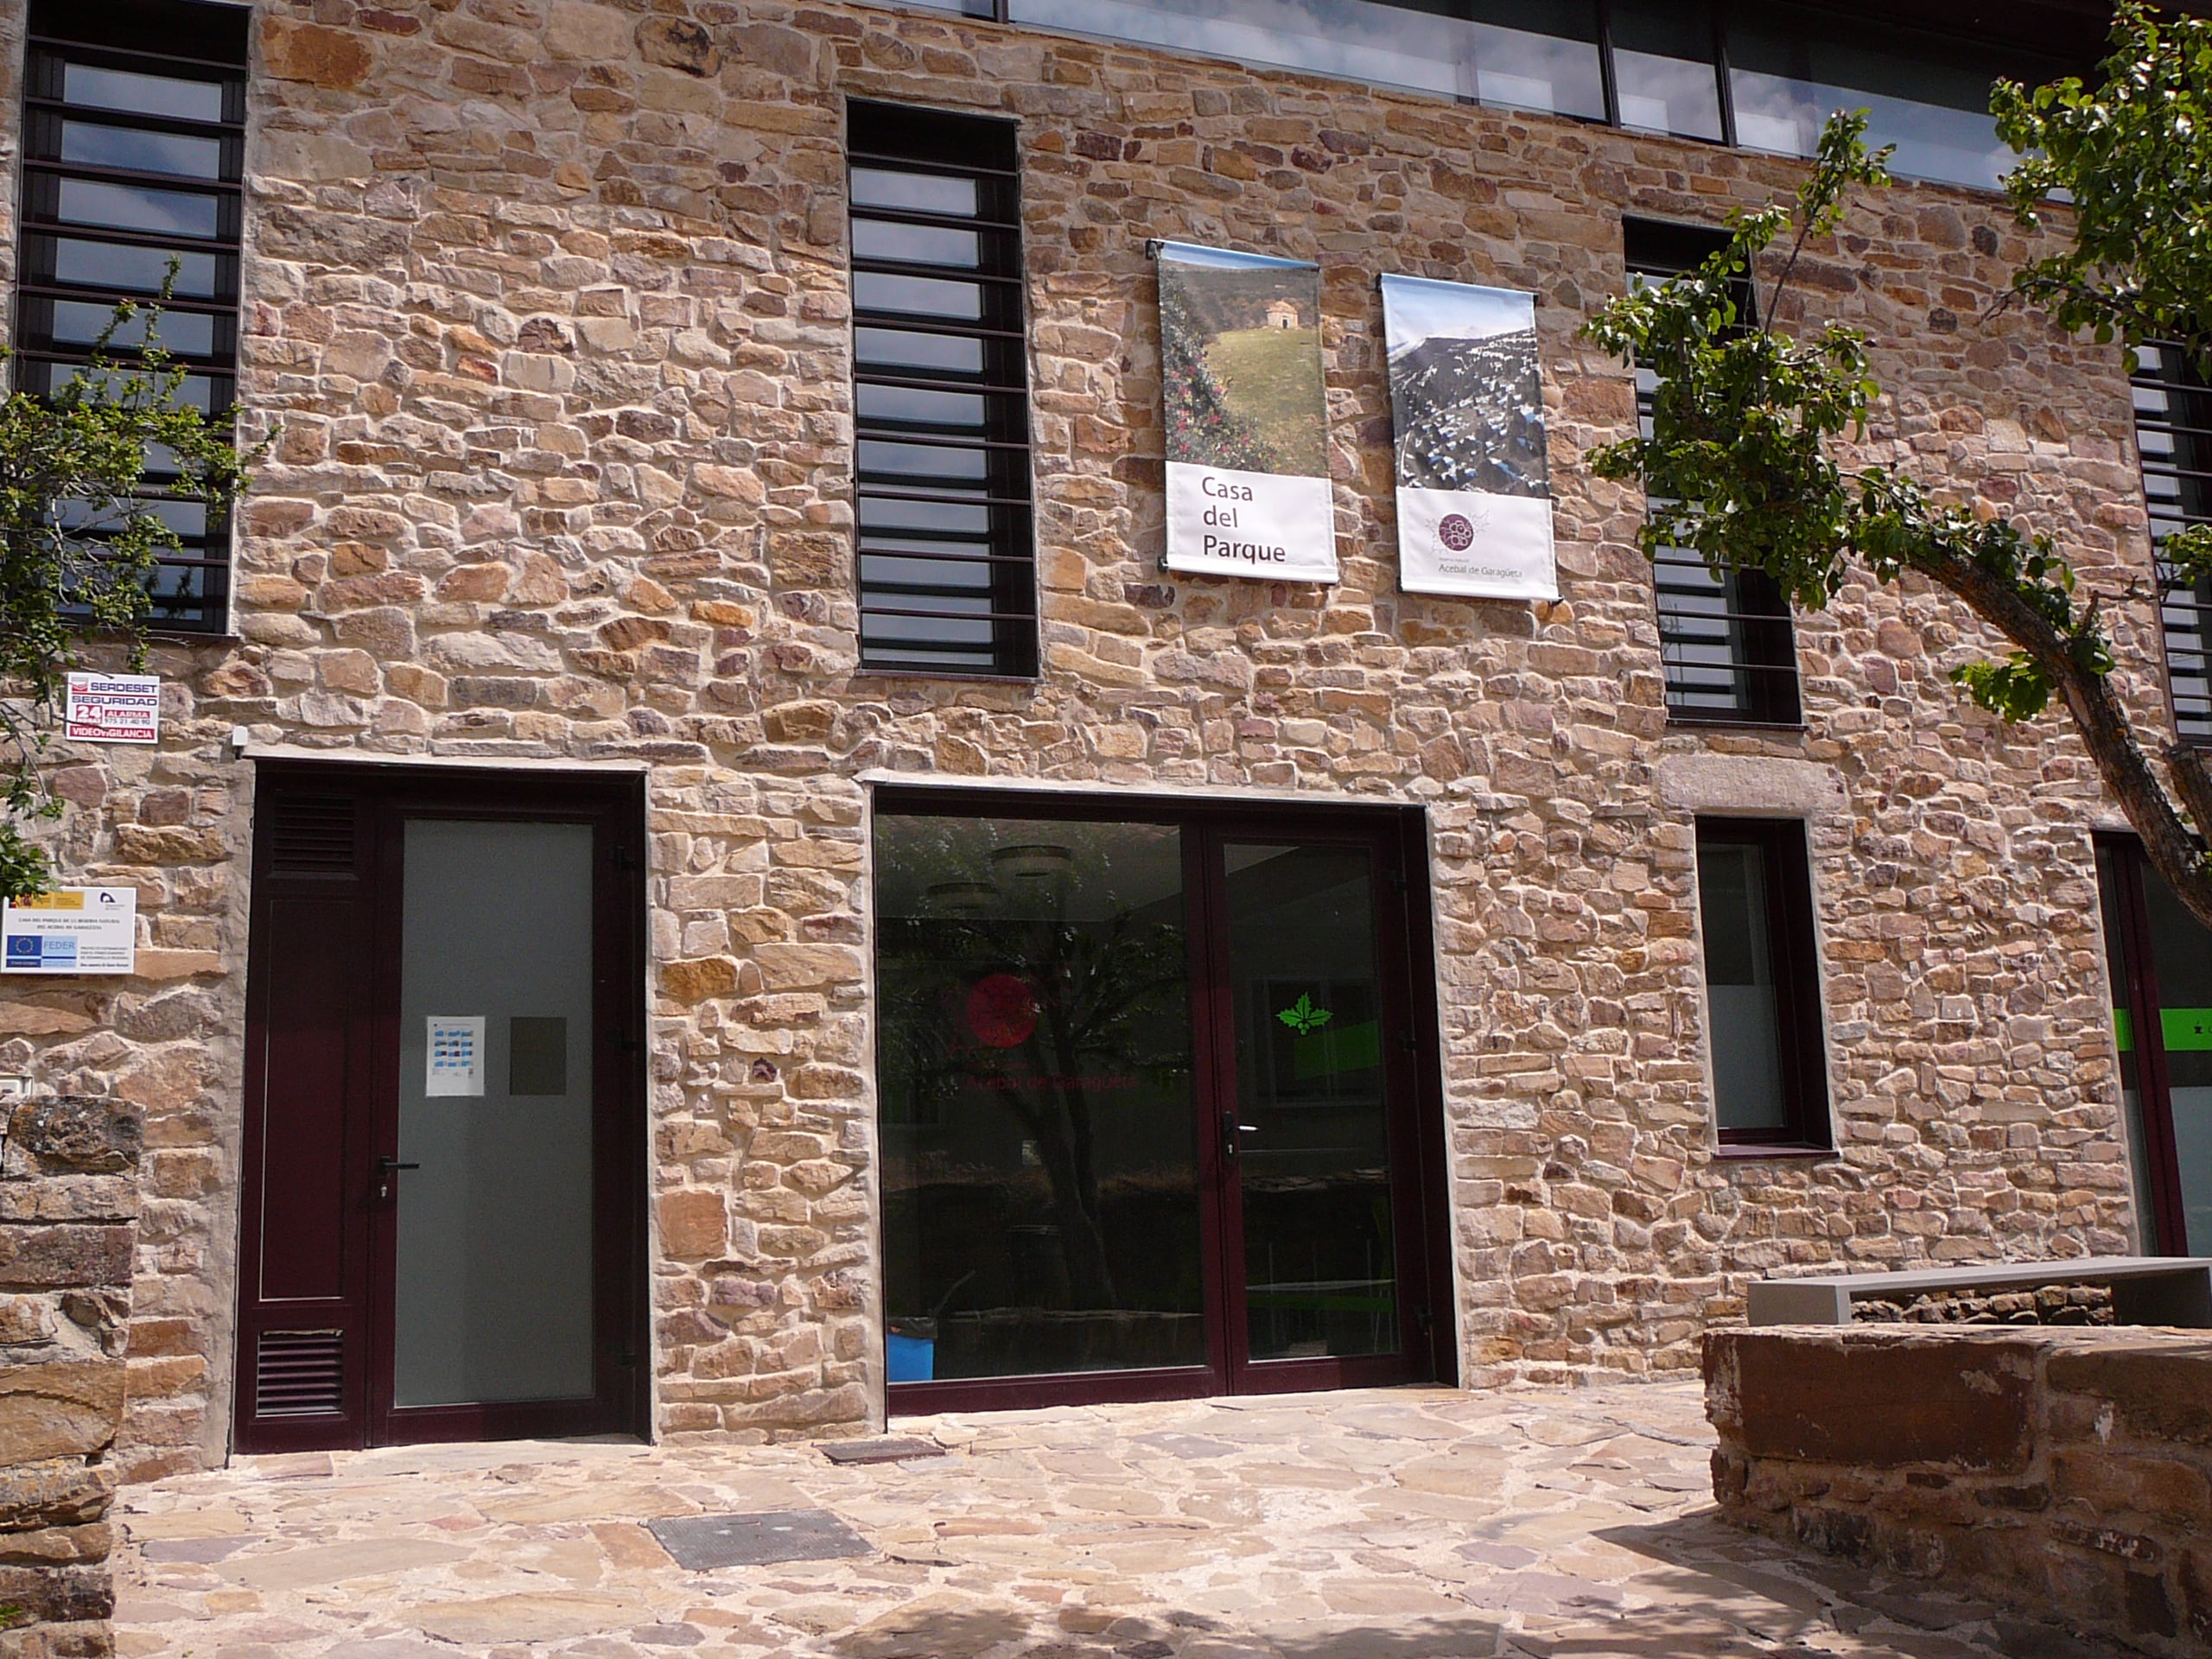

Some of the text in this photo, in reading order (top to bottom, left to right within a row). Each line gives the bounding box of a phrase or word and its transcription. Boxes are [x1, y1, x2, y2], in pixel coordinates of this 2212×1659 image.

[1202, 477, 1252, 501] Casa
[1203, 505, 1238, 528] del
[1204, 535, 1286, 565] Parque
[1438, 563, 1467, 574] Acebal
[1470, 566, 1480, 575] de
[91, 683, 157, 692] SERDESET
[72, 696, 156, 705] SEGURIDAD
[77, 706, 101, 719] 24
[44, 941, 75, 950] FEDER
